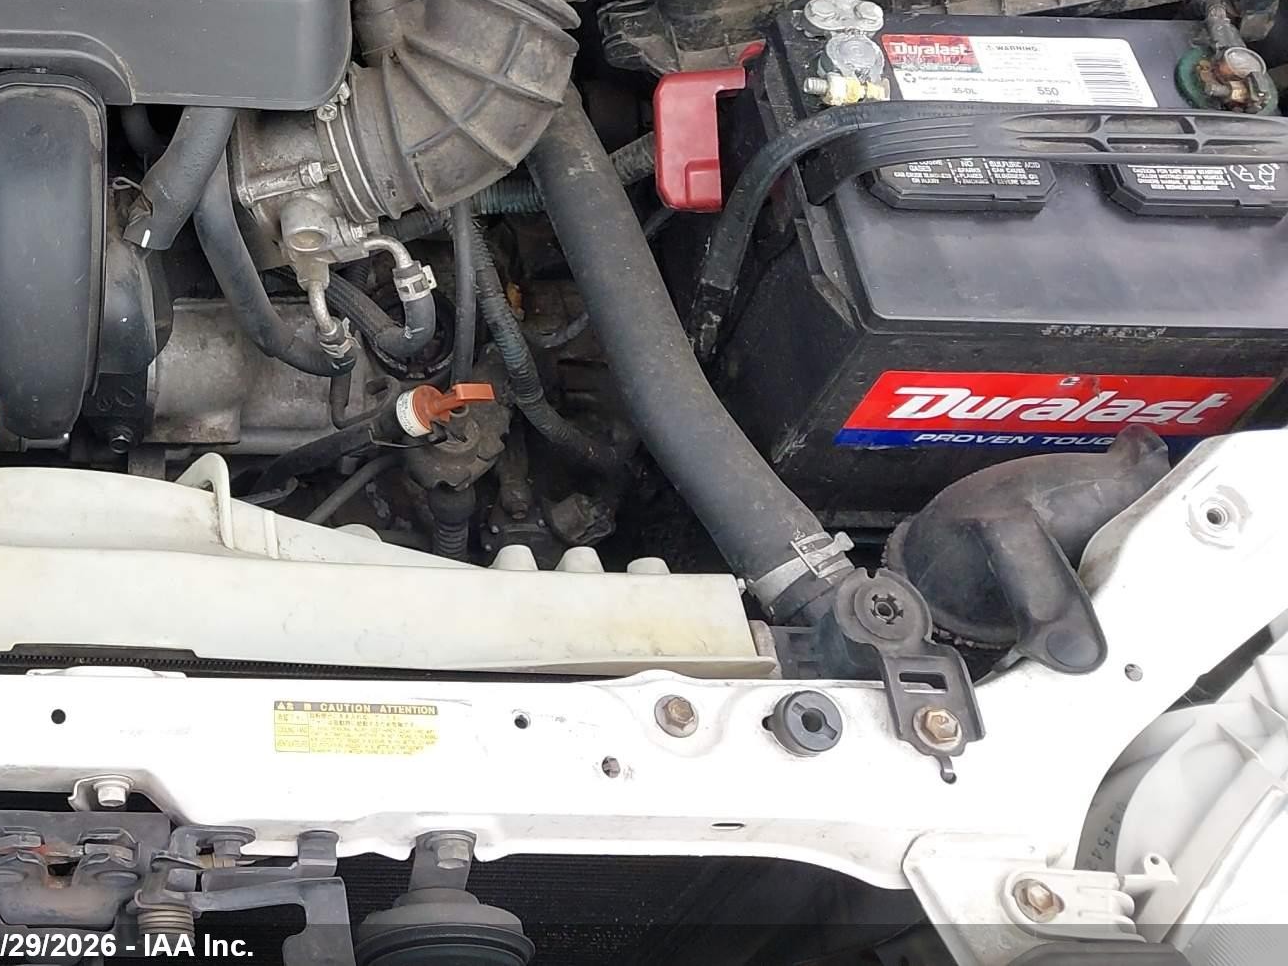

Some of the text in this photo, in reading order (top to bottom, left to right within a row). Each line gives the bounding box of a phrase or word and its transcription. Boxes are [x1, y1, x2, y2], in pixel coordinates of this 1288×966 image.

[888, 41, 968, 58] Duralast
[1037, 86, 1059, 96] 550
[888, 386, 1232, 425] Duralast
[913, 432, 1037, 446] PROVEN
[319, 703, 371, 713] CAUTION
[379, 704, 436, 715] ATTENTION
